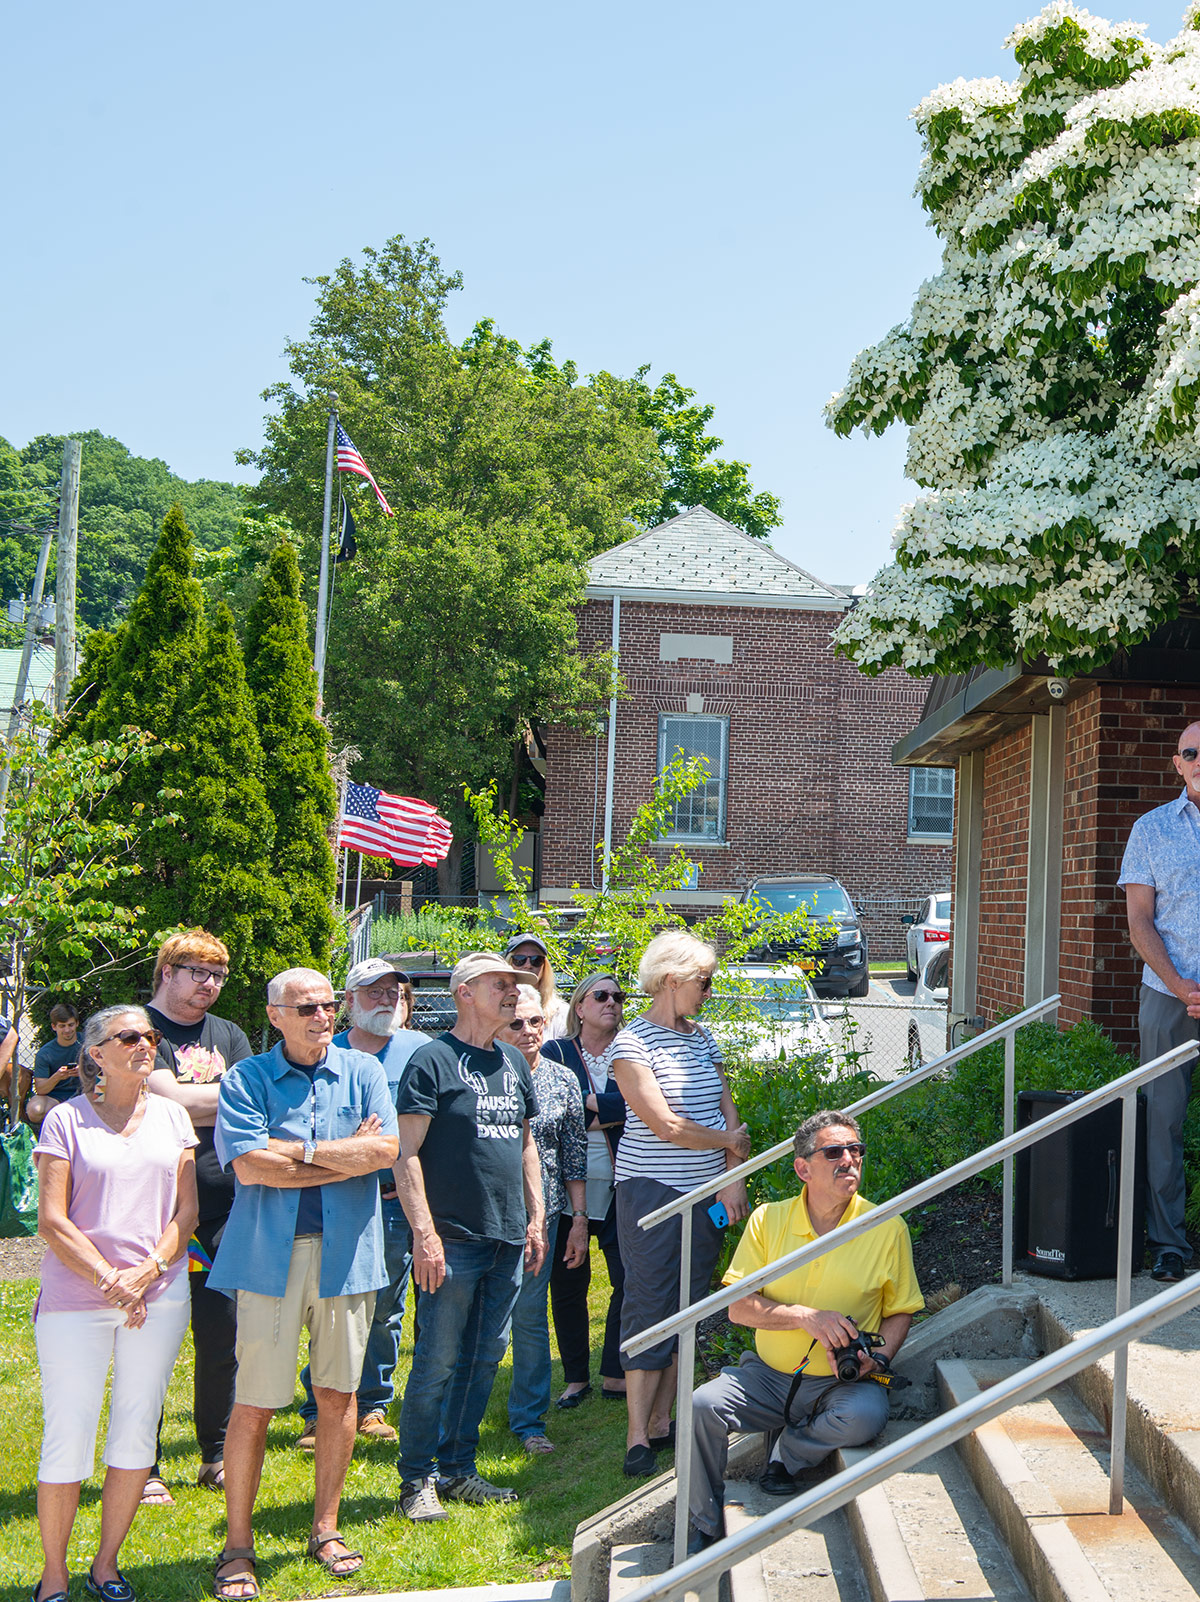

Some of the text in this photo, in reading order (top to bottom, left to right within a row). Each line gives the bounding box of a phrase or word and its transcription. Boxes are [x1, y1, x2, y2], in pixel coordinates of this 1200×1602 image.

[419, 1015, 440, 1023] Jeep
[476, 1095, 519, 1111] MUSIC
[476, 1110, 519, 1124] IS MY
[476, 1123, 519, 1139] DRUG
